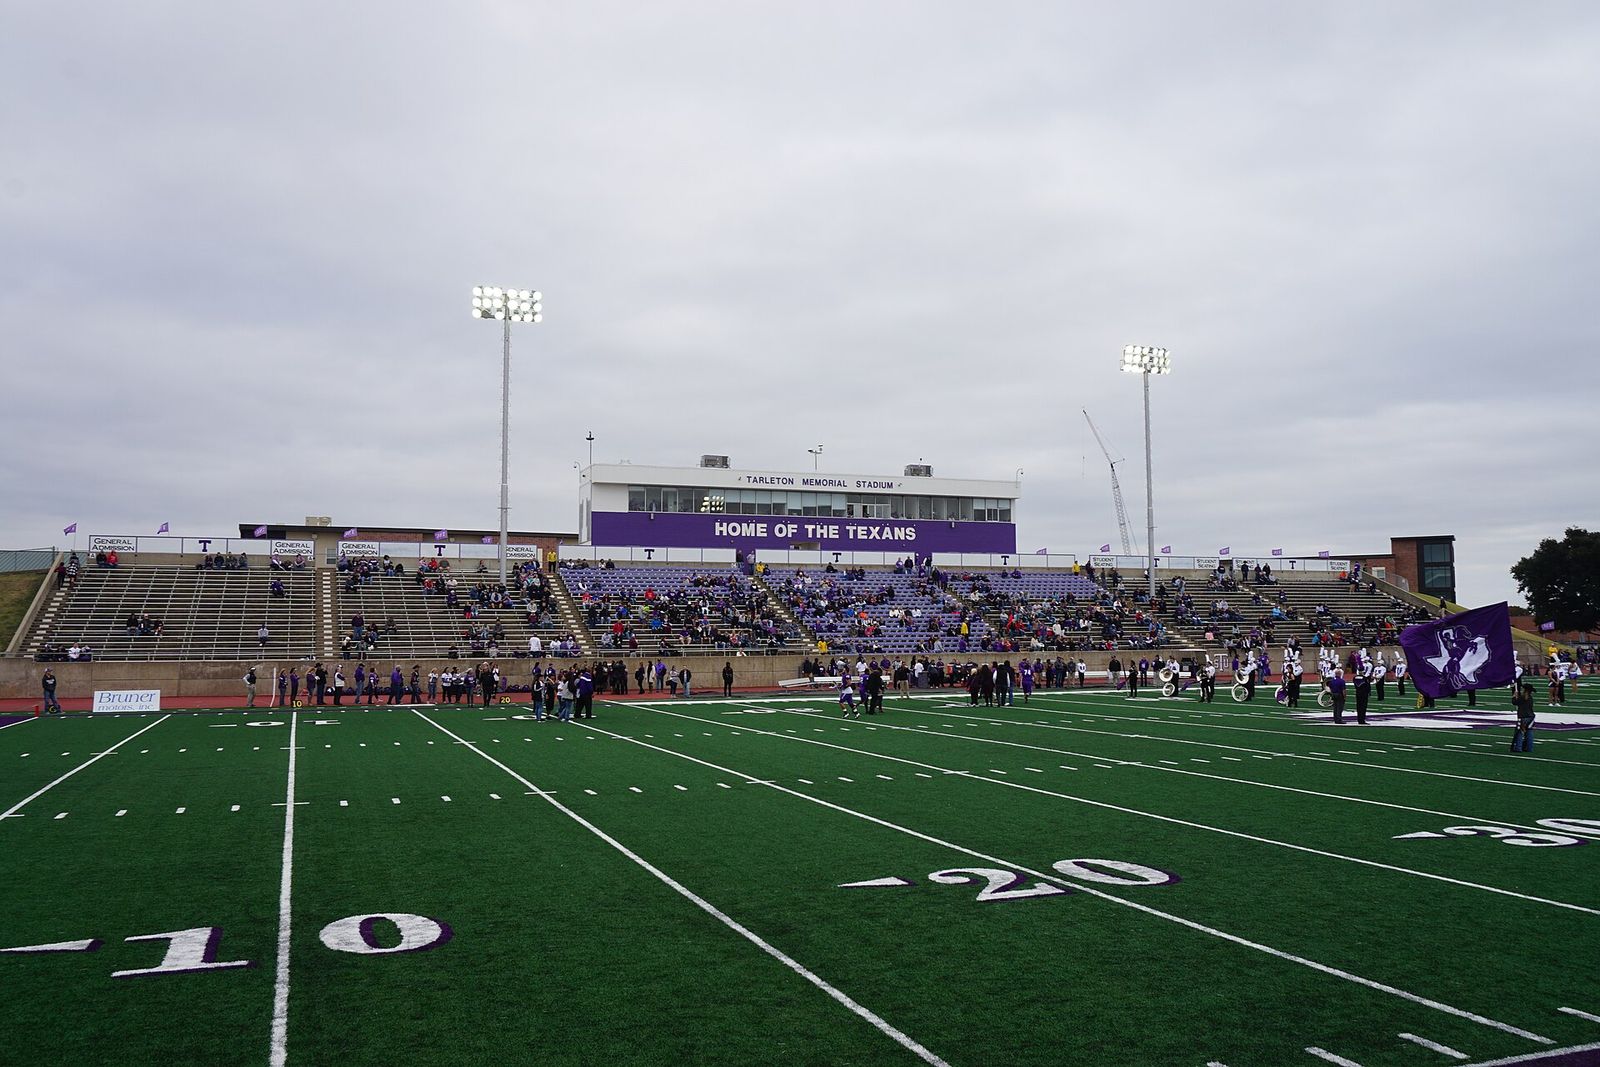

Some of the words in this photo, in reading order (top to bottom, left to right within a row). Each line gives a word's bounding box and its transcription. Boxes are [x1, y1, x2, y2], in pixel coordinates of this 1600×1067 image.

[746, 475, 794, 485] TARLETON
[802, 478, 848, 488] MEMORIAL
[856, 480, 894, 489] STADIUM
[715, 522, 768, 537] HOME
[774, 523, 798, 538] OF
[804, 524, 840, 539] THE
[845, 525, 917, 541] TEXANS
[94, 537, 132, 545] GENERAL
[198, 540, 212, 552] T
[275, 541, 310, 549] GENERAL
[434, 545, 446, 556] T
[644, 549, 655, 560] T
[832, 552, 842, 561] T
[1001, 555, 1010, 565] T
[1289, 561, 1297, 570] T
[98, 692, 156, 704] Bruner
